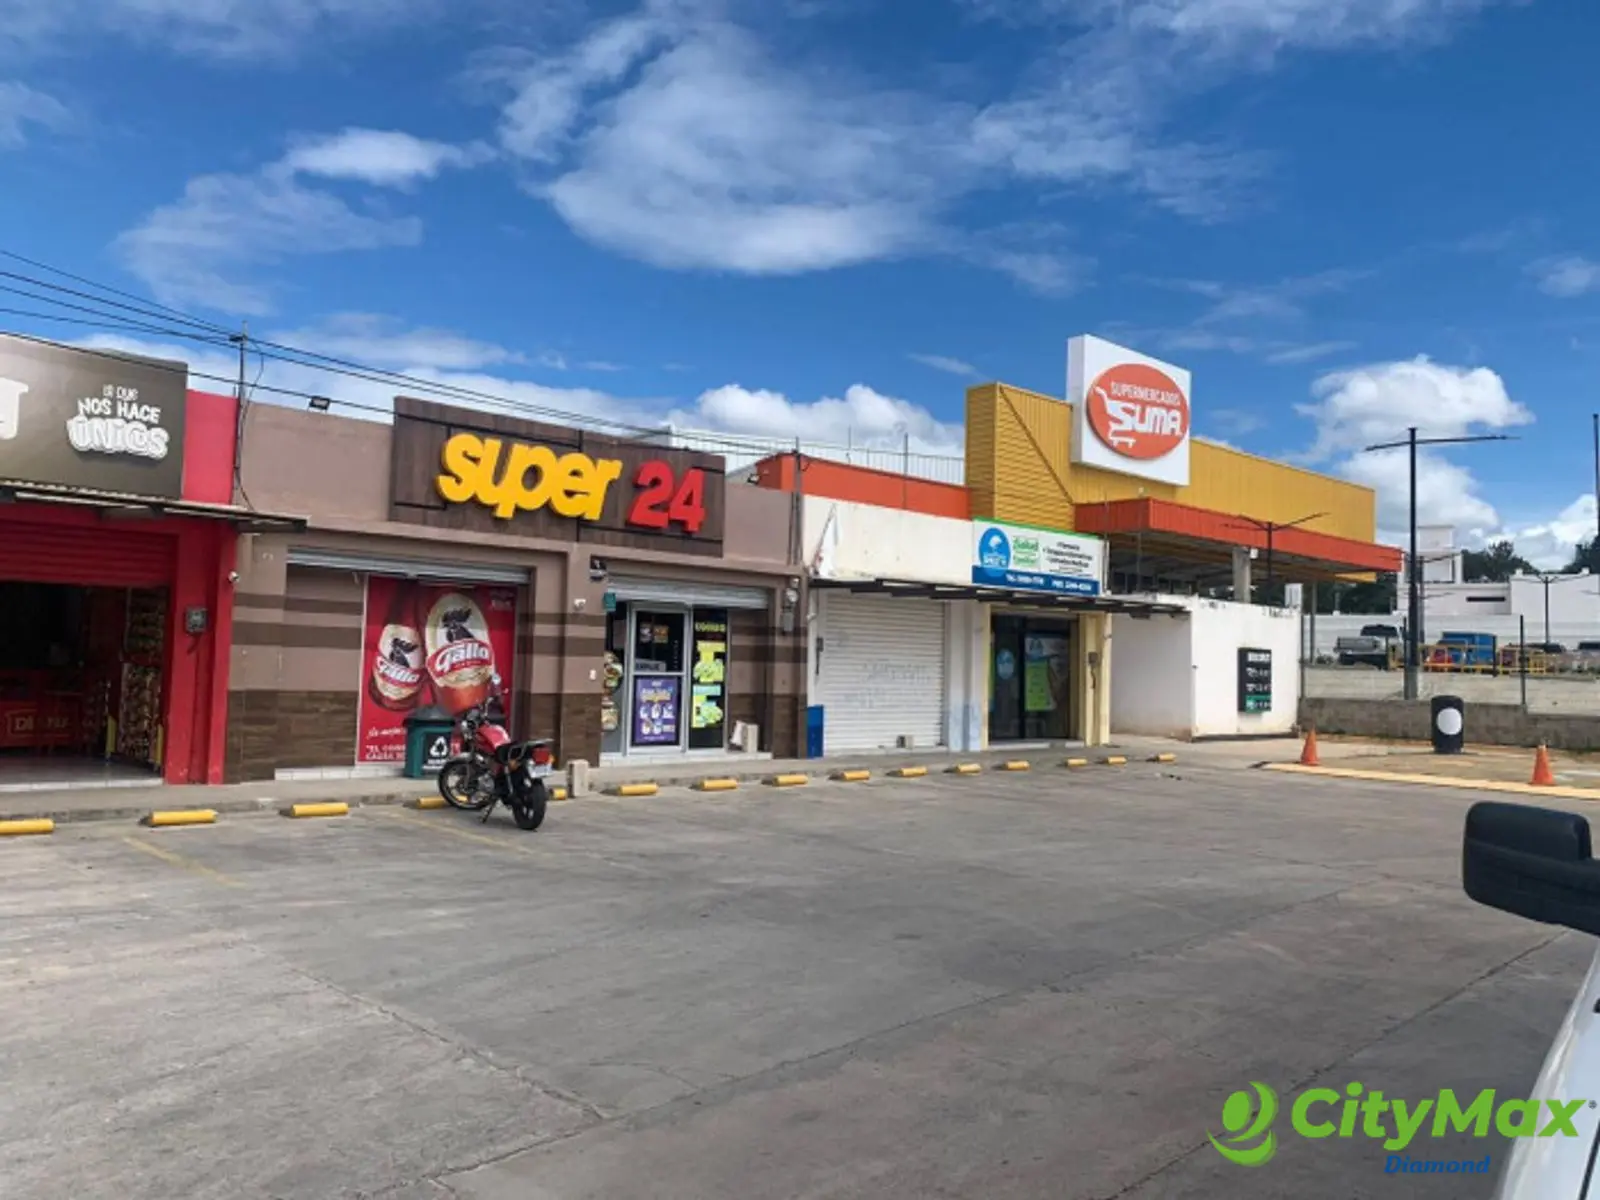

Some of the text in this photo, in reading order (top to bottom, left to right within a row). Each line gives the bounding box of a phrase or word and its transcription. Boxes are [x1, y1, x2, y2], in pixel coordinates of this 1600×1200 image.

[1111, 381, 1181, 405] SUPERMERCADOS
[77, 398, 161, 424] NOS HACE
[1106, 400, 1183, 436] SUMA
[438, 432, 706, 532] super 24
[376, 656, 420, 682] Gallo
[434, 643, 489, 673] Gallo
